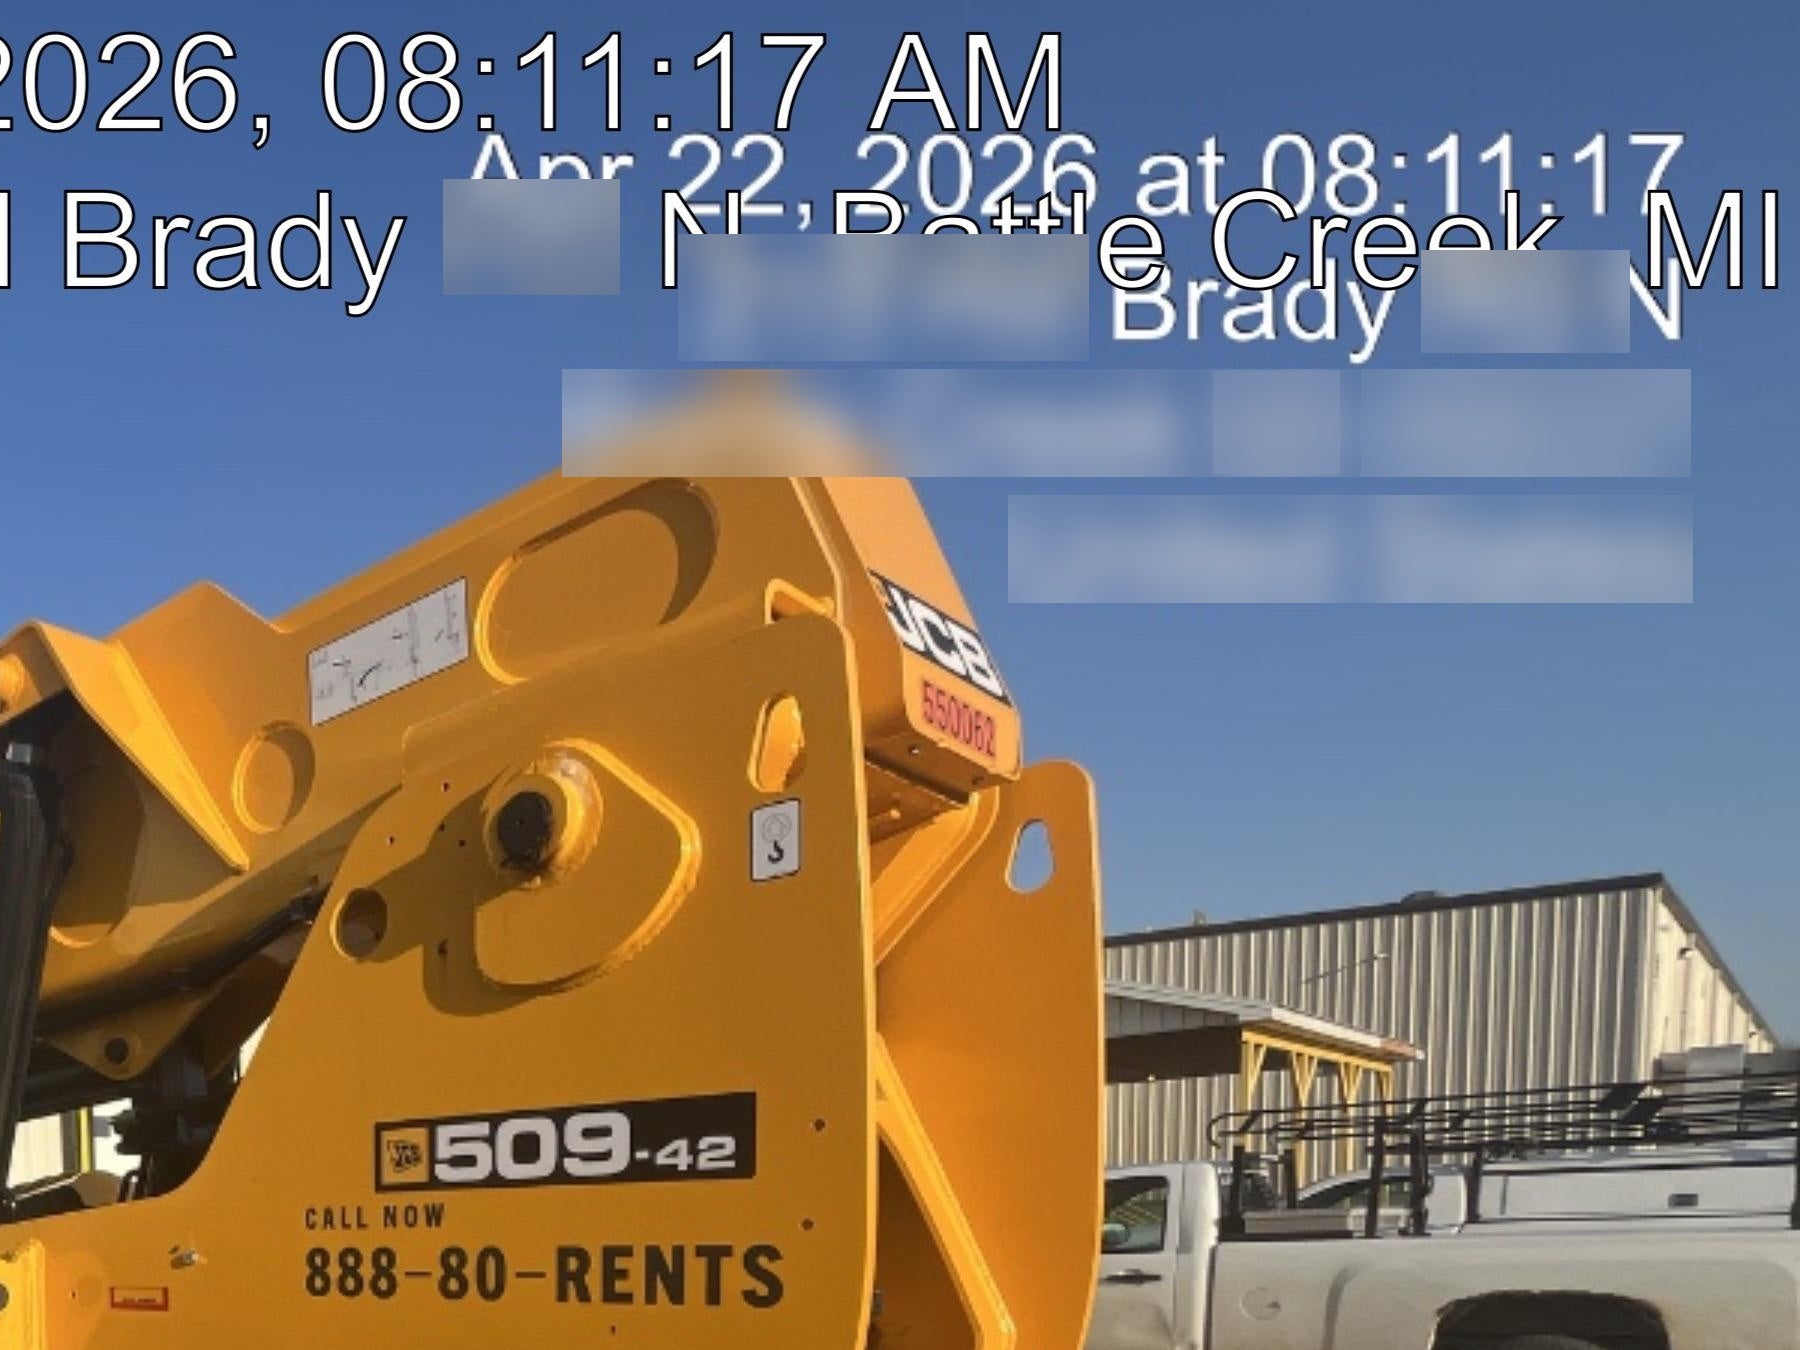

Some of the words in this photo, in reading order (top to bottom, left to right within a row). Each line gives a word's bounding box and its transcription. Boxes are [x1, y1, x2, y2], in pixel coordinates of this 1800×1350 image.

[884, 584, 1005, 698] JCB
[434, 1111, 737, 1182] 509-42
[305, 1206, 368, 1230] CALL
[383, 1203, 446, 1228] NOW
[305, 1244, 785, 1309] 888-80-RENTS
